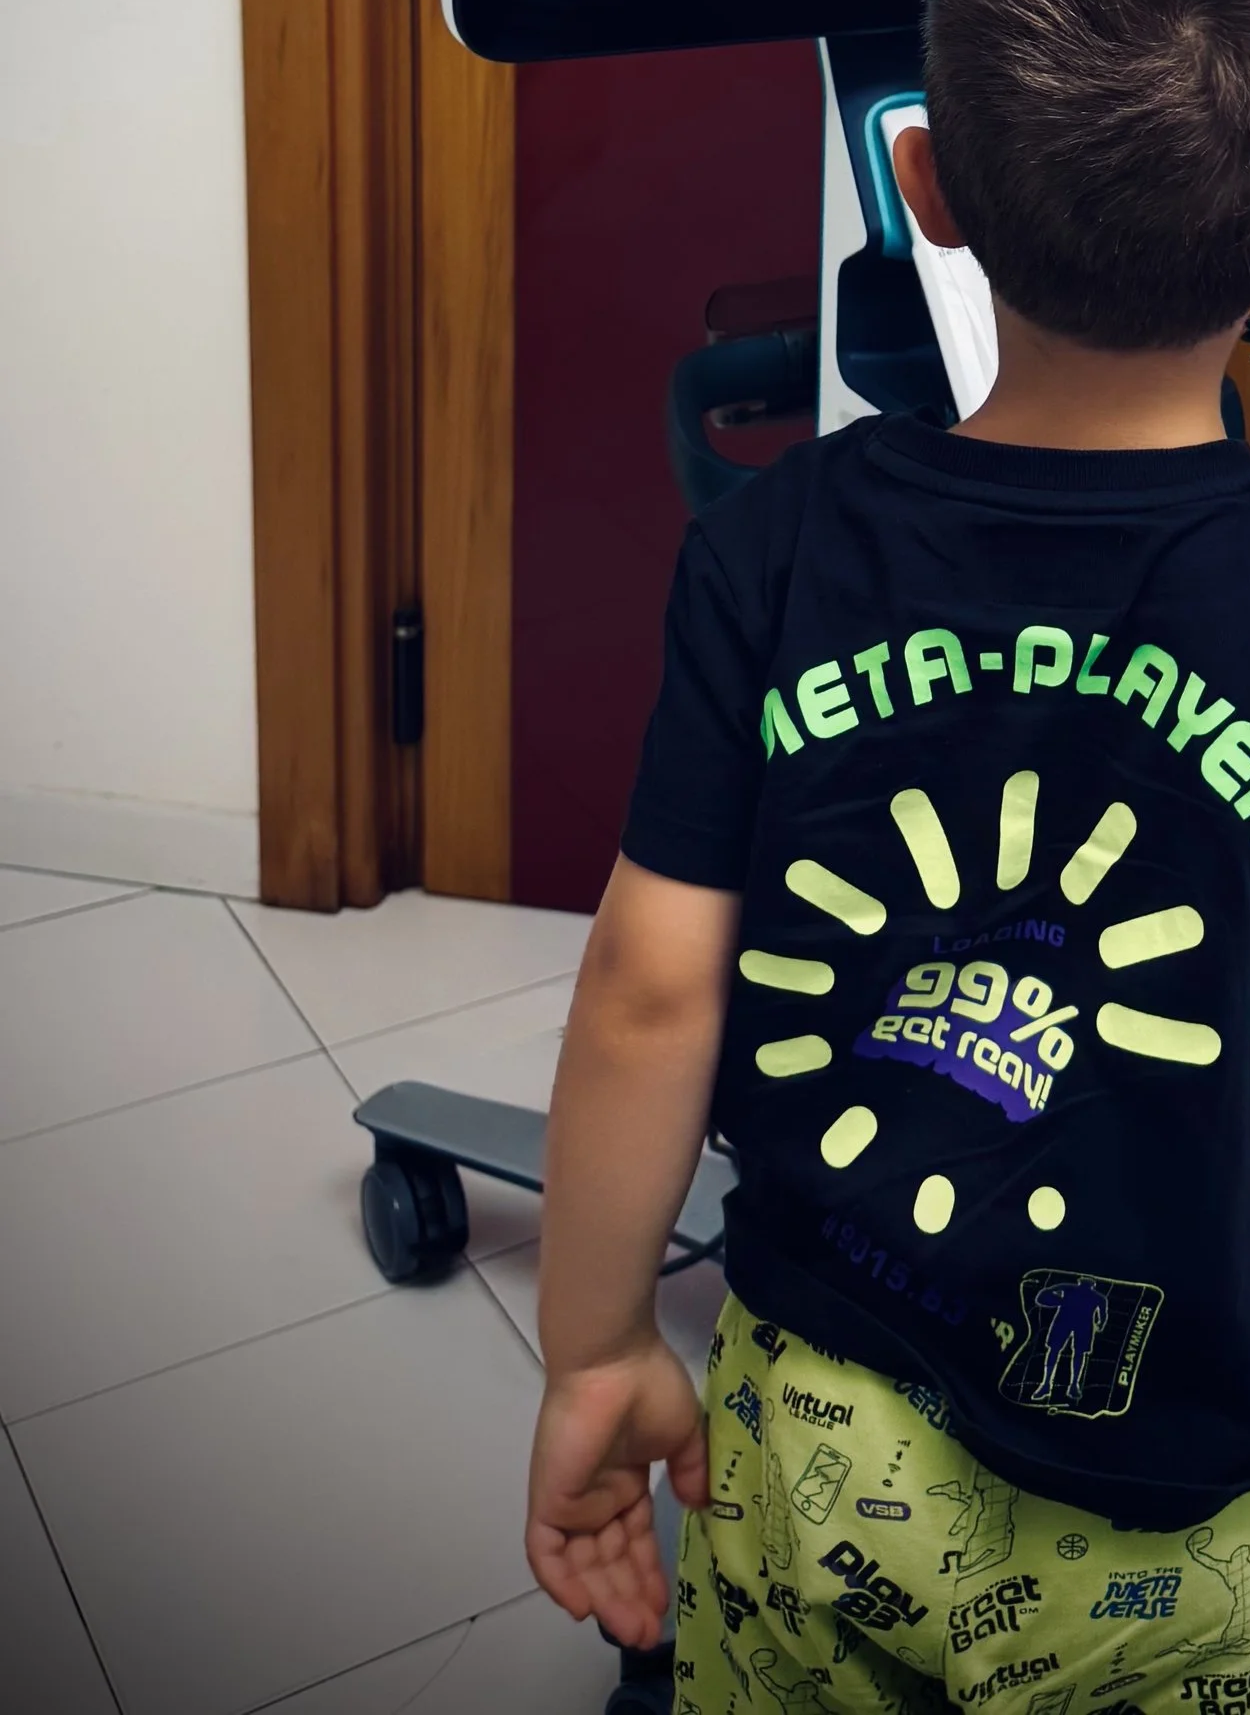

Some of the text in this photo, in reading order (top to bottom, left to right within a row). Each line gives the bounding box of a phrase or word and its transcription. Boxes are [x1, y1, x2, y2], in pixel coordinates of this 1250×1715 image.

[933, 918, 1066, 954] LOADING
[871, 1015, 951, 1050] get
[897, 960, 1080, 1071] 99%
[1117, 1306, 1153, 1386] PLAYMAKER
[783, 1382, 854, 1427] Virtual
[789, 1408, 834, 1430] LEAGUE
[861, 1501, 905, 1517] VSB
[1103, 1575, 1182, 1601] META
[1108, 1567, 1183, 1580] INTO THE
[832, 1590, 902, 1631] 83
[1090, 1597, 1178, 1620] VERSE
[951, 1605, 1020, 1654] Ball
[959, 1653, 1060, 1702] Virtual
